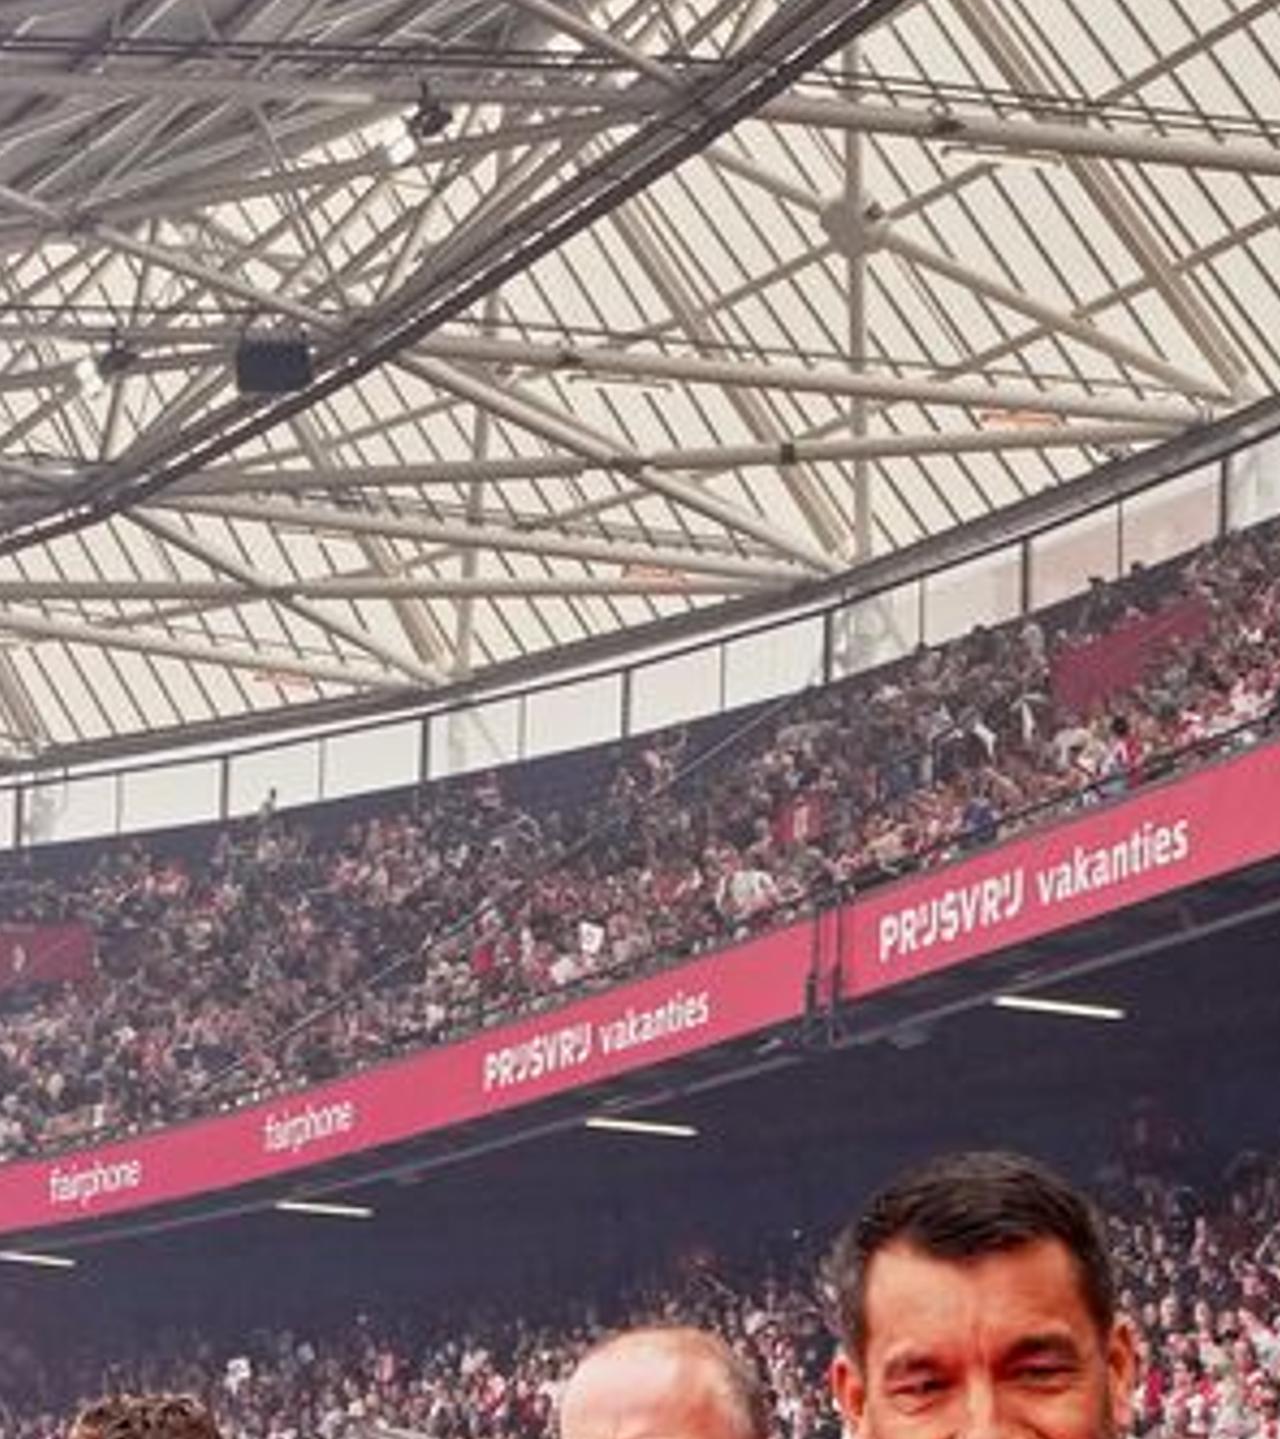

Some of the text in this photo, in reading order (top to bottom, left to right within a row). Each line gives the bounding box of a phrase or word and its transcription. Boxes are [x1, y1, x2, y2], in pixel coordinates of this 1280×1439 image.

[1036, 819, 1189, 905] vakanties
[598, 991, 709, 1054] vakanties
[265, 1103, 352, 1153] fairphone
[50, 1161, 140, 1207] fairphone
